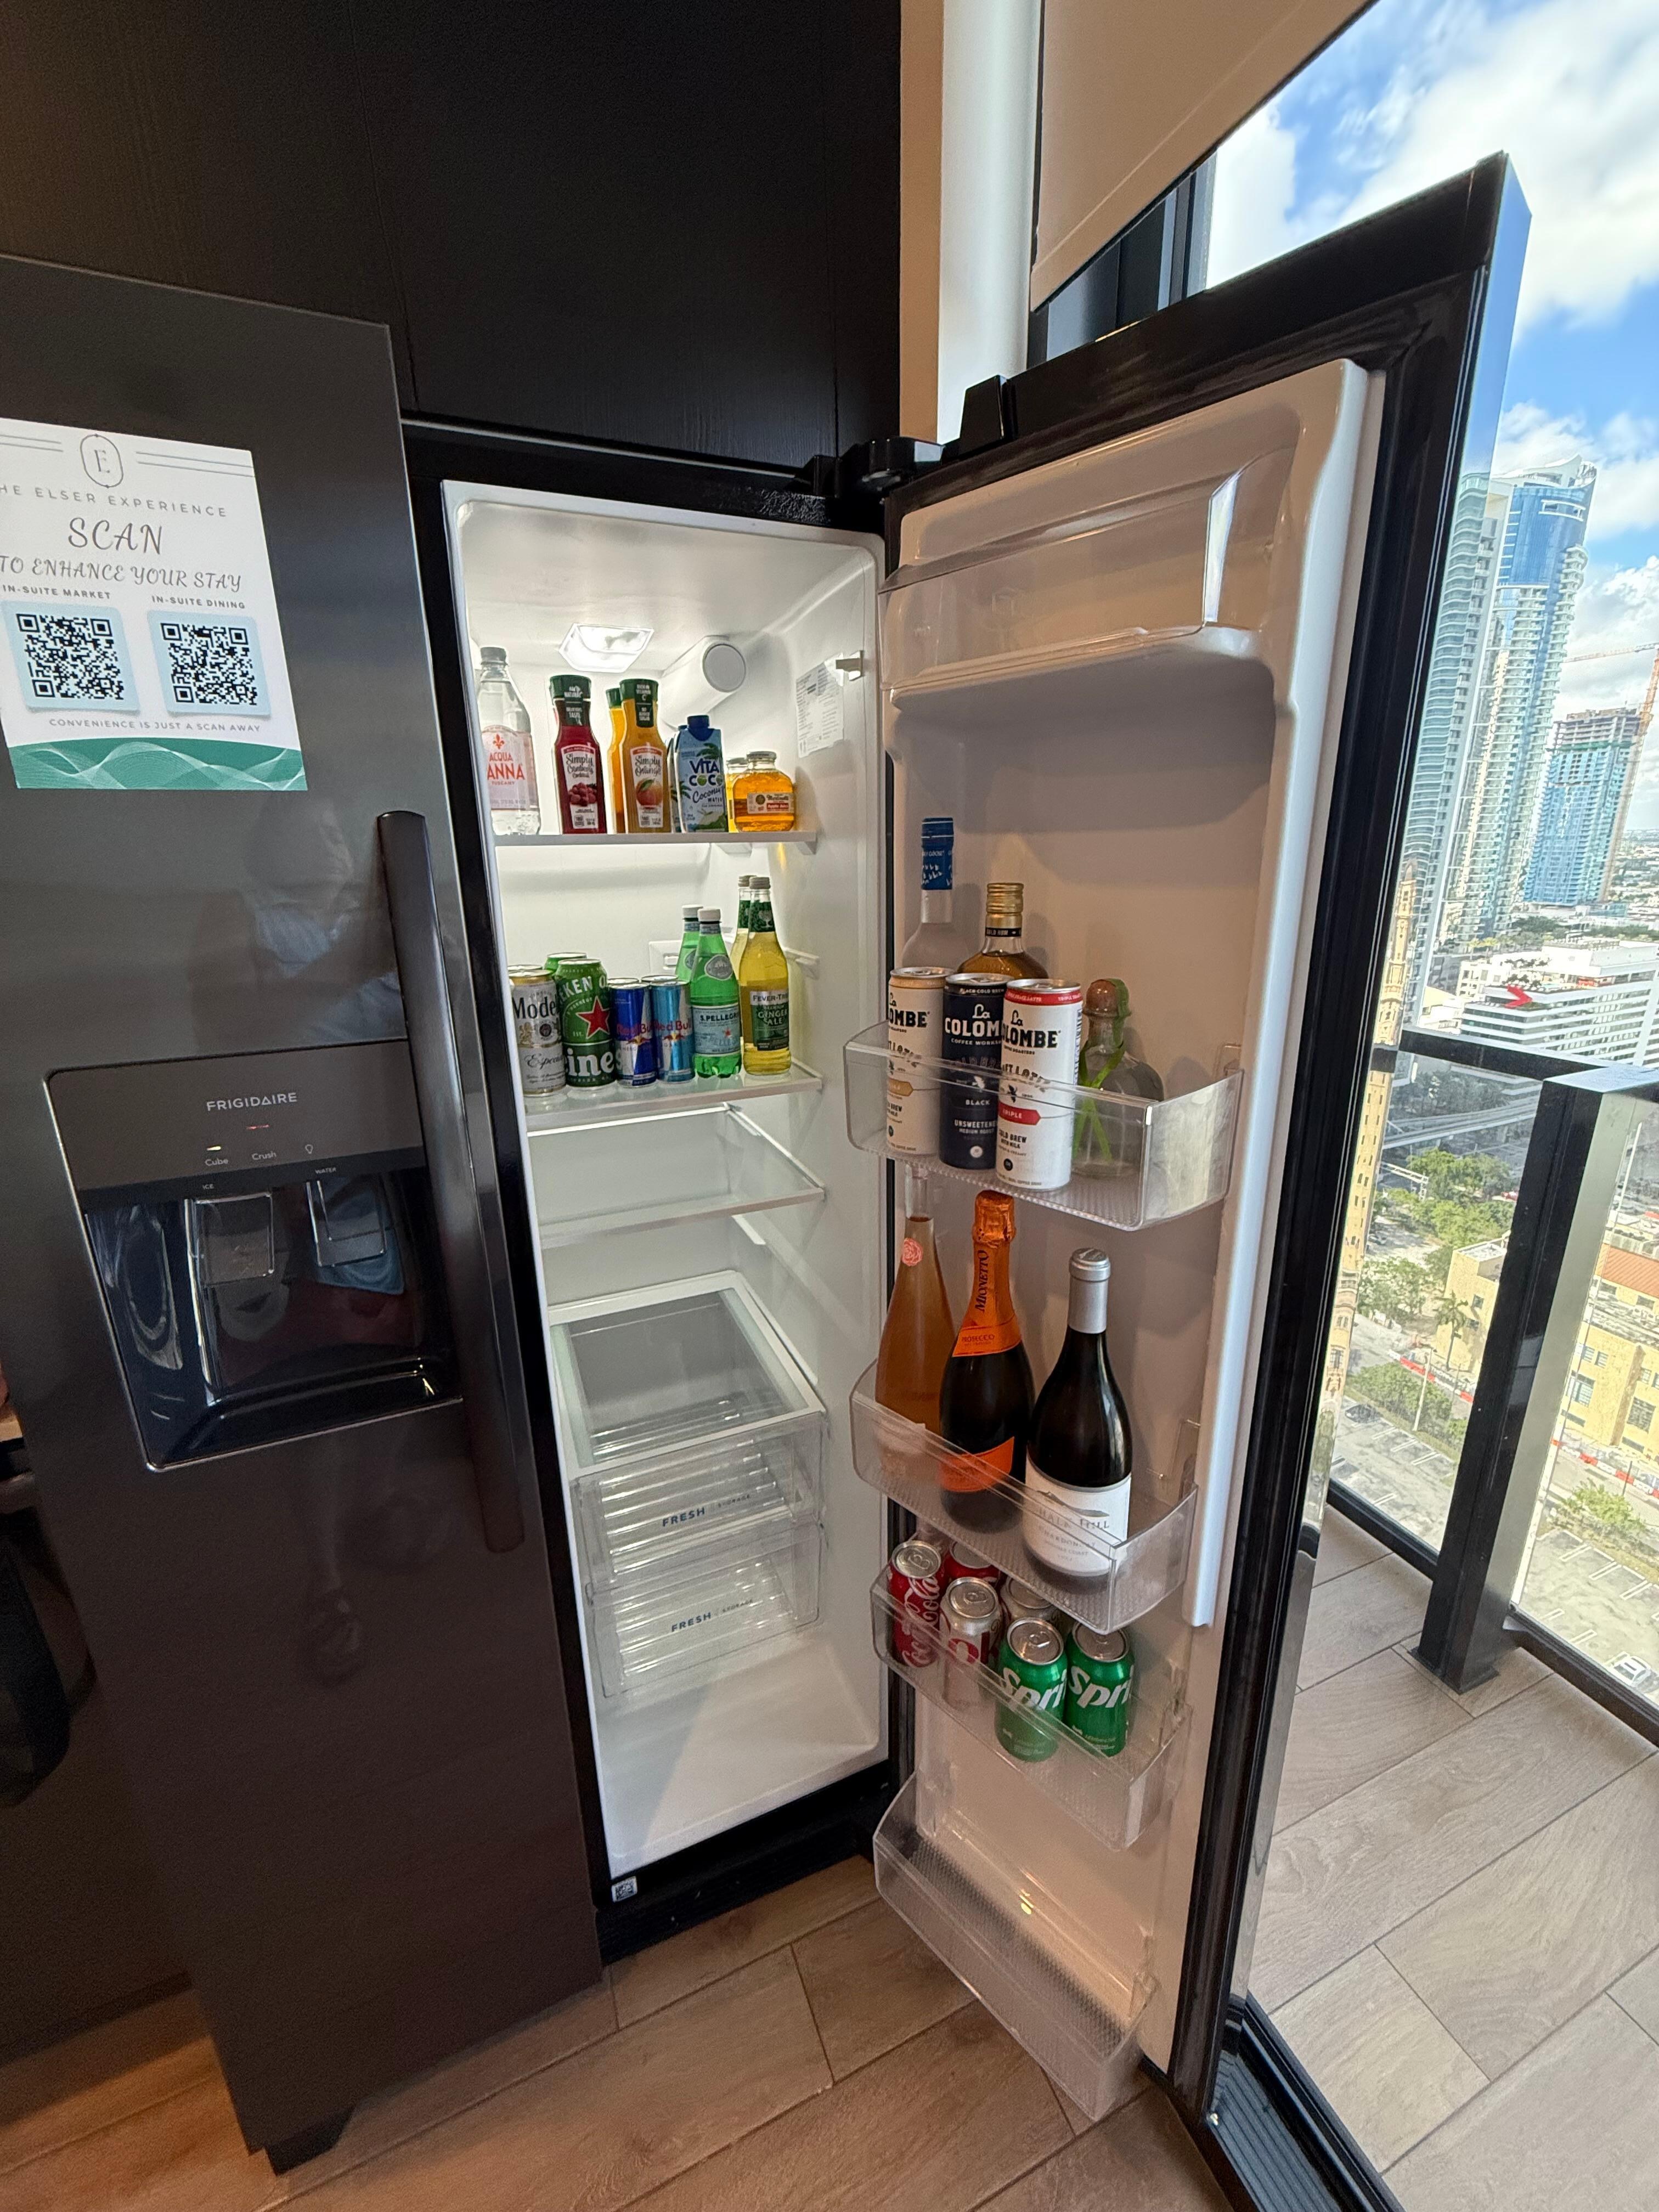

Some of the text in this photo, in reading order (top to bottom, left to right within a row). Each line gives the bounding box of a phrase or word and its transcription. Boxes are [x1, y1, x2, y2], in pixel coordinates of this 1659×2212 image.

[35, 487, 95, 503] ELSER
[108, 495, 226, 517] EXPERIENCE
[68, 517, 162, 555] SCAN
[0, 555, 241, 593] TO ENHANCE YOUR STAY
[2, 584, 111, 600] IN-SUITE MARKET
[151, 595, 245, 610] IN-SUITE DINING
[48, 718, 261, 732] CONVENIENCE IS JUST A SCAN AWAY
[489, 752, 514, 761] ACQUA
[566, 753, 594, 766] Simply
[635, 754, 661, 767] Simply
[487, 763, 526, 780] ANNA
[689, 758, 720, 774] VITA
[689, 774, 724, 787] COCO
[972, 1003, 991, 1019] La
[1011, 1009, 1024, 1027] La
[206, 1092, 298, 1112] FRIGIDAIRE
[1002, 1108, 1023, 1119] TRIPLE
[1009, 1133, 1027, 1143] BREW
[1009, 1141, 1021, 1149] MILK
[204, 1150, 277, 1167] Cube Crush
[974, 1249, 989, 1313] MIONETTO
[961, 1334, 995, 1342] PROSECCO
[662, 1506, 706, 1527] FRESH
[671, 1612, 712, 1633] FRESH
